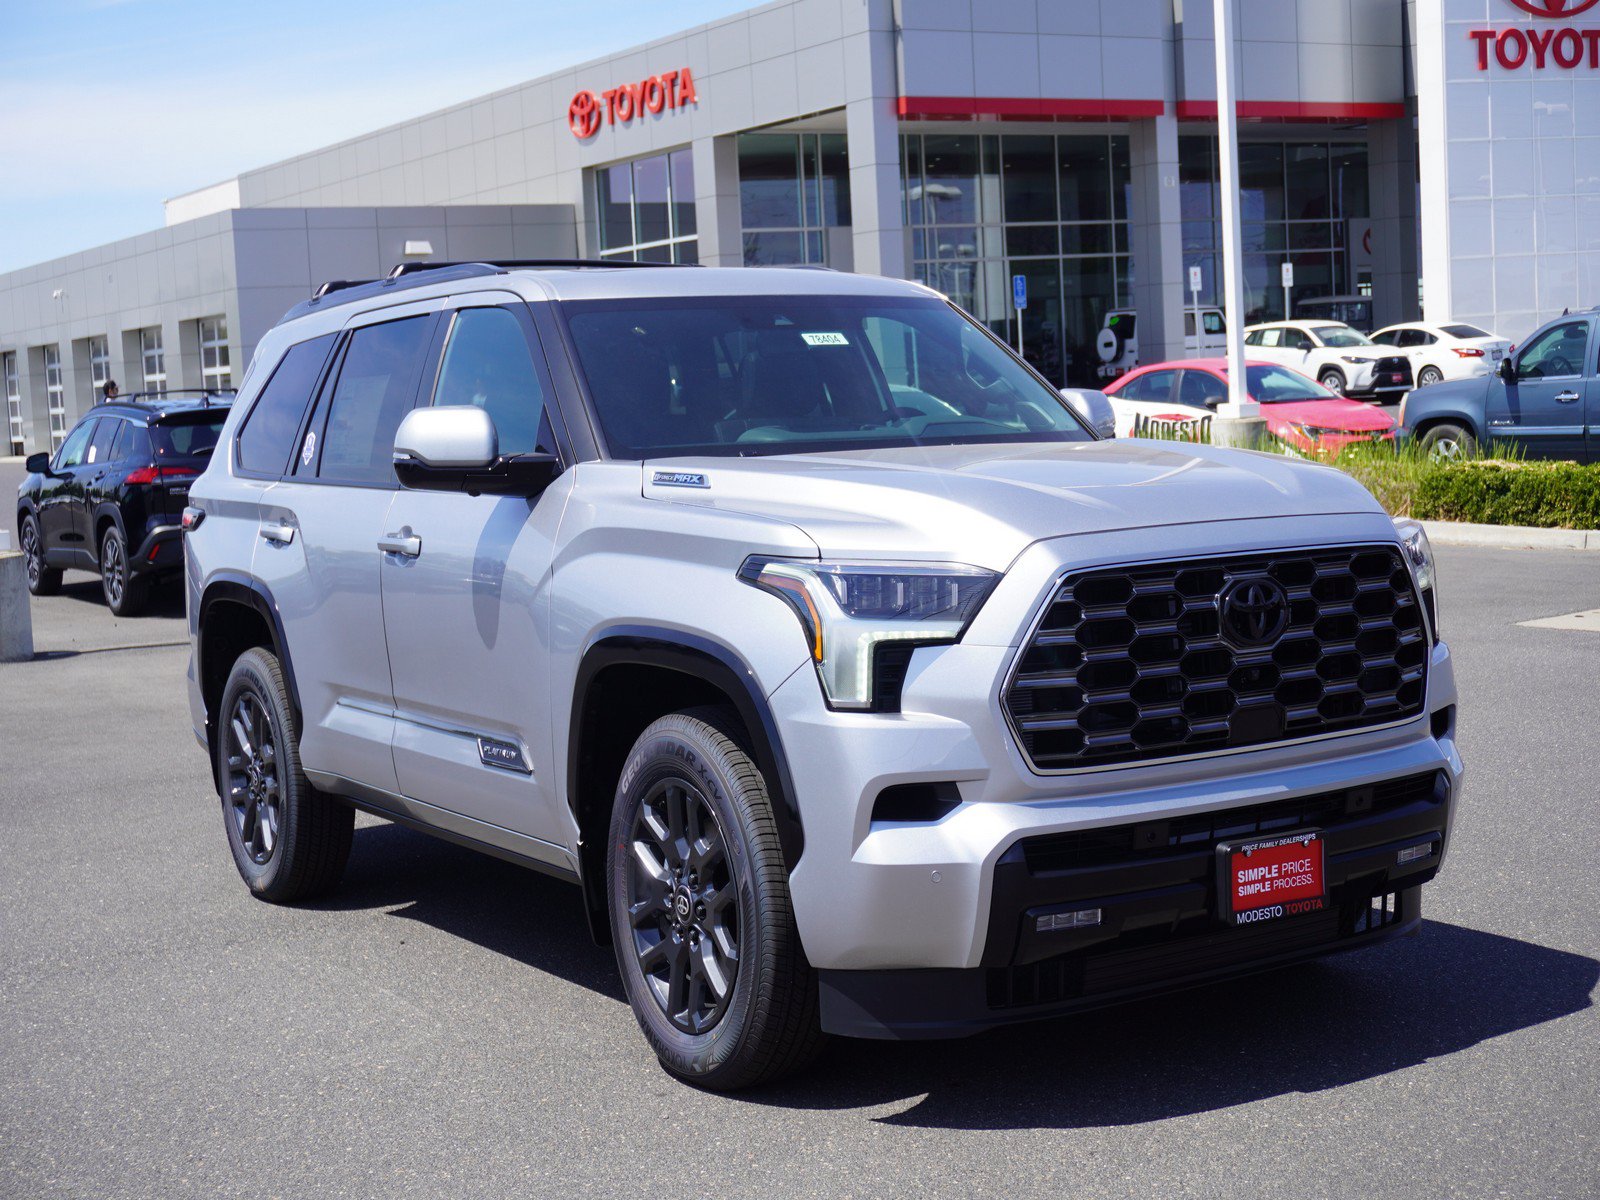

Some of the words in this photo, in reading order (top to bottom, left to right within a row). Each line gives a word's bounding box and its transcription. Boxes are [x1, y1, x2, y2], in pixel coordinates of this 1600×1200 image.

[602, 67, 698, 126] TOYOTA
[1133, 412, 1213, 445] MODESTO
[621, 740, 697, 795] GEOLNDAR
[1241, 843, 1258, 852] PRICE
[1259, 840, 1279, 850] FAMILY
[1279, 833, 1316, 846] DEALERSHIPS
[1237, 864, 1279, 883] SIMPLE
[1281, 858, 1314, 876] PRICE.
[1238, 881, 1271, 897] SIMPLE
[1273, 873, 1315, 890] PROCESS.
[1236, 905, 1283, 925] MODESTO
[1285, 898, 1323, 914] TOYOTA
